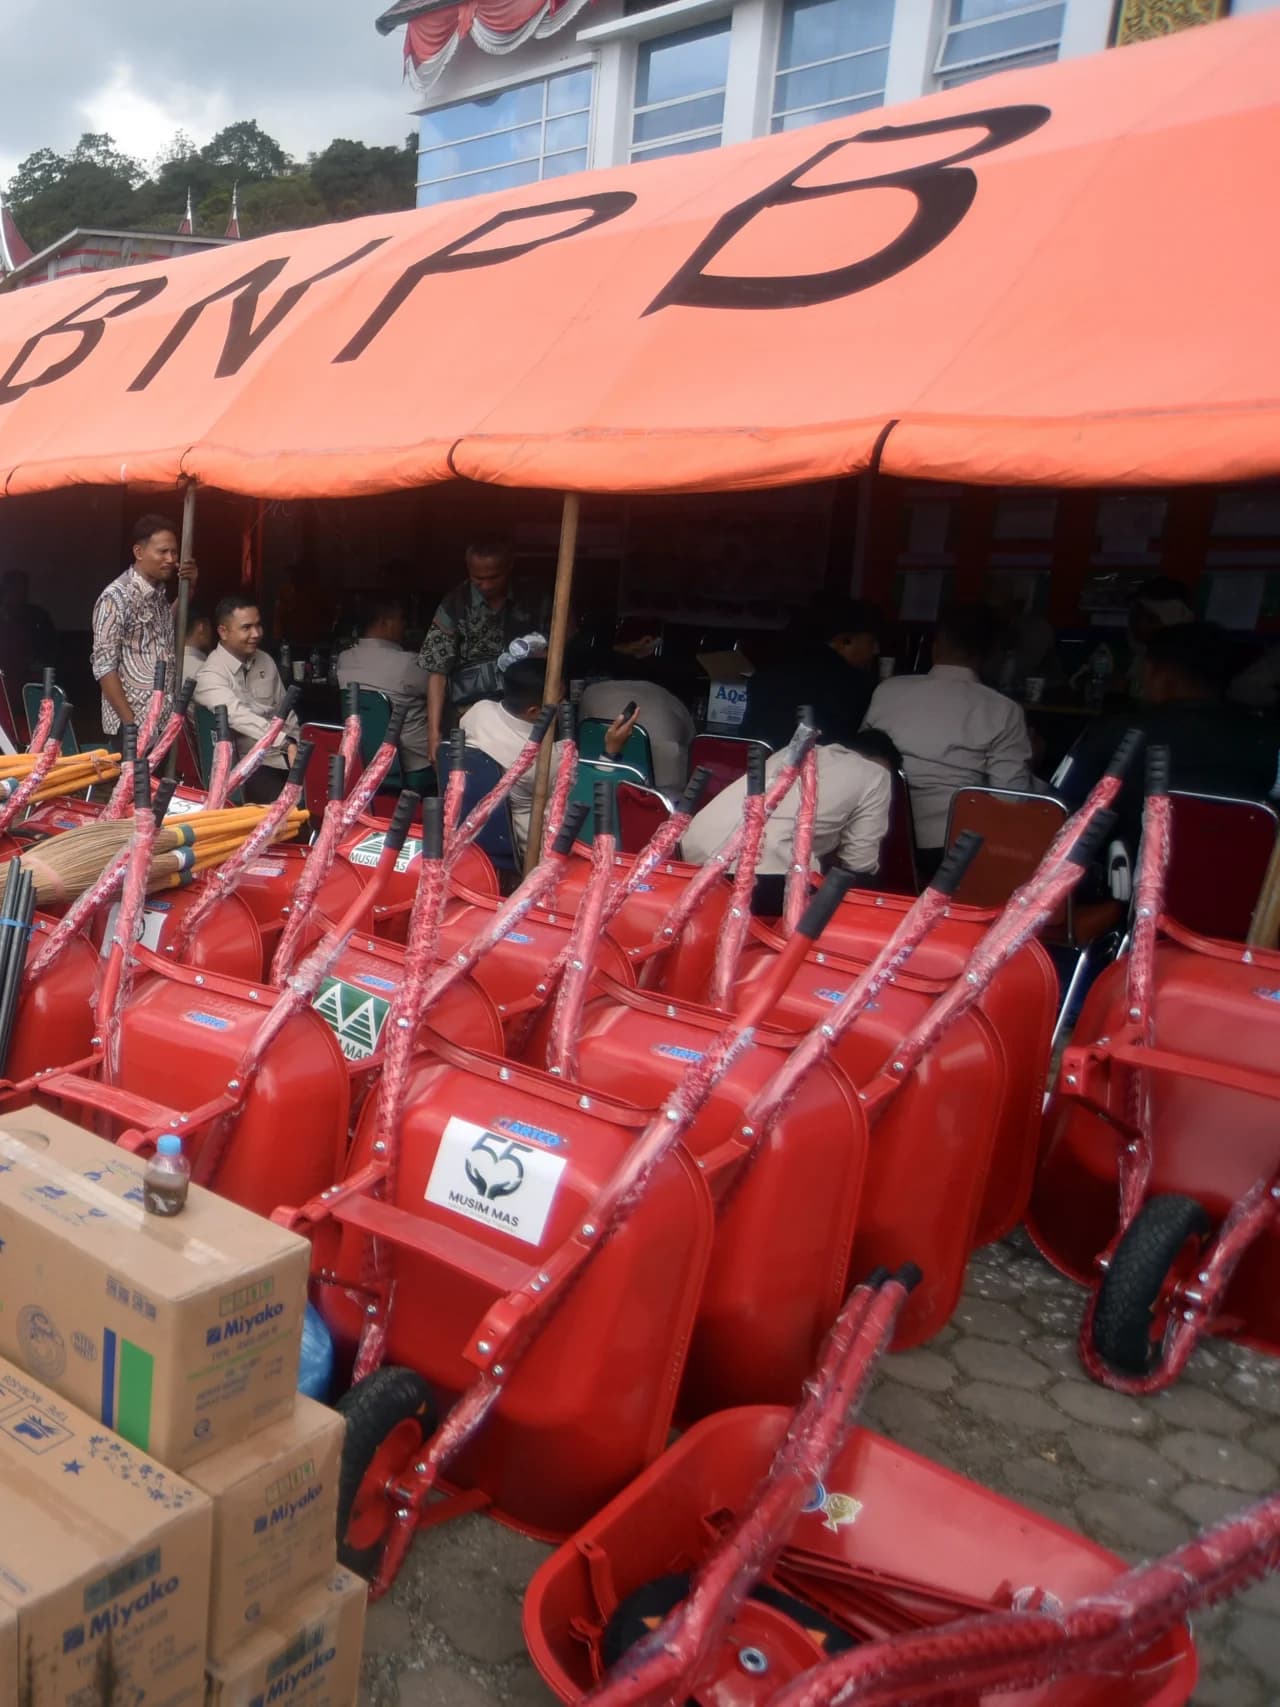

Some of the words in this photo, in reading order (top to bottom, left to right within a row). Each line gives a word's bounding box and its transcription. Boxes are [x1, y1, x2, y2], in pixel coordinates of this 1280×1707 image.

[448, 1190, 490, 1215] MUSIM
[491, 1208, 519, 1227] MAS
[224, 1303, 284, 1340] Miyako
[270, 1484, 323, 1527] Miyako
[90, 1576, 180, 1640] Miyako
[267, 1647, 337, 1705] Miyako
